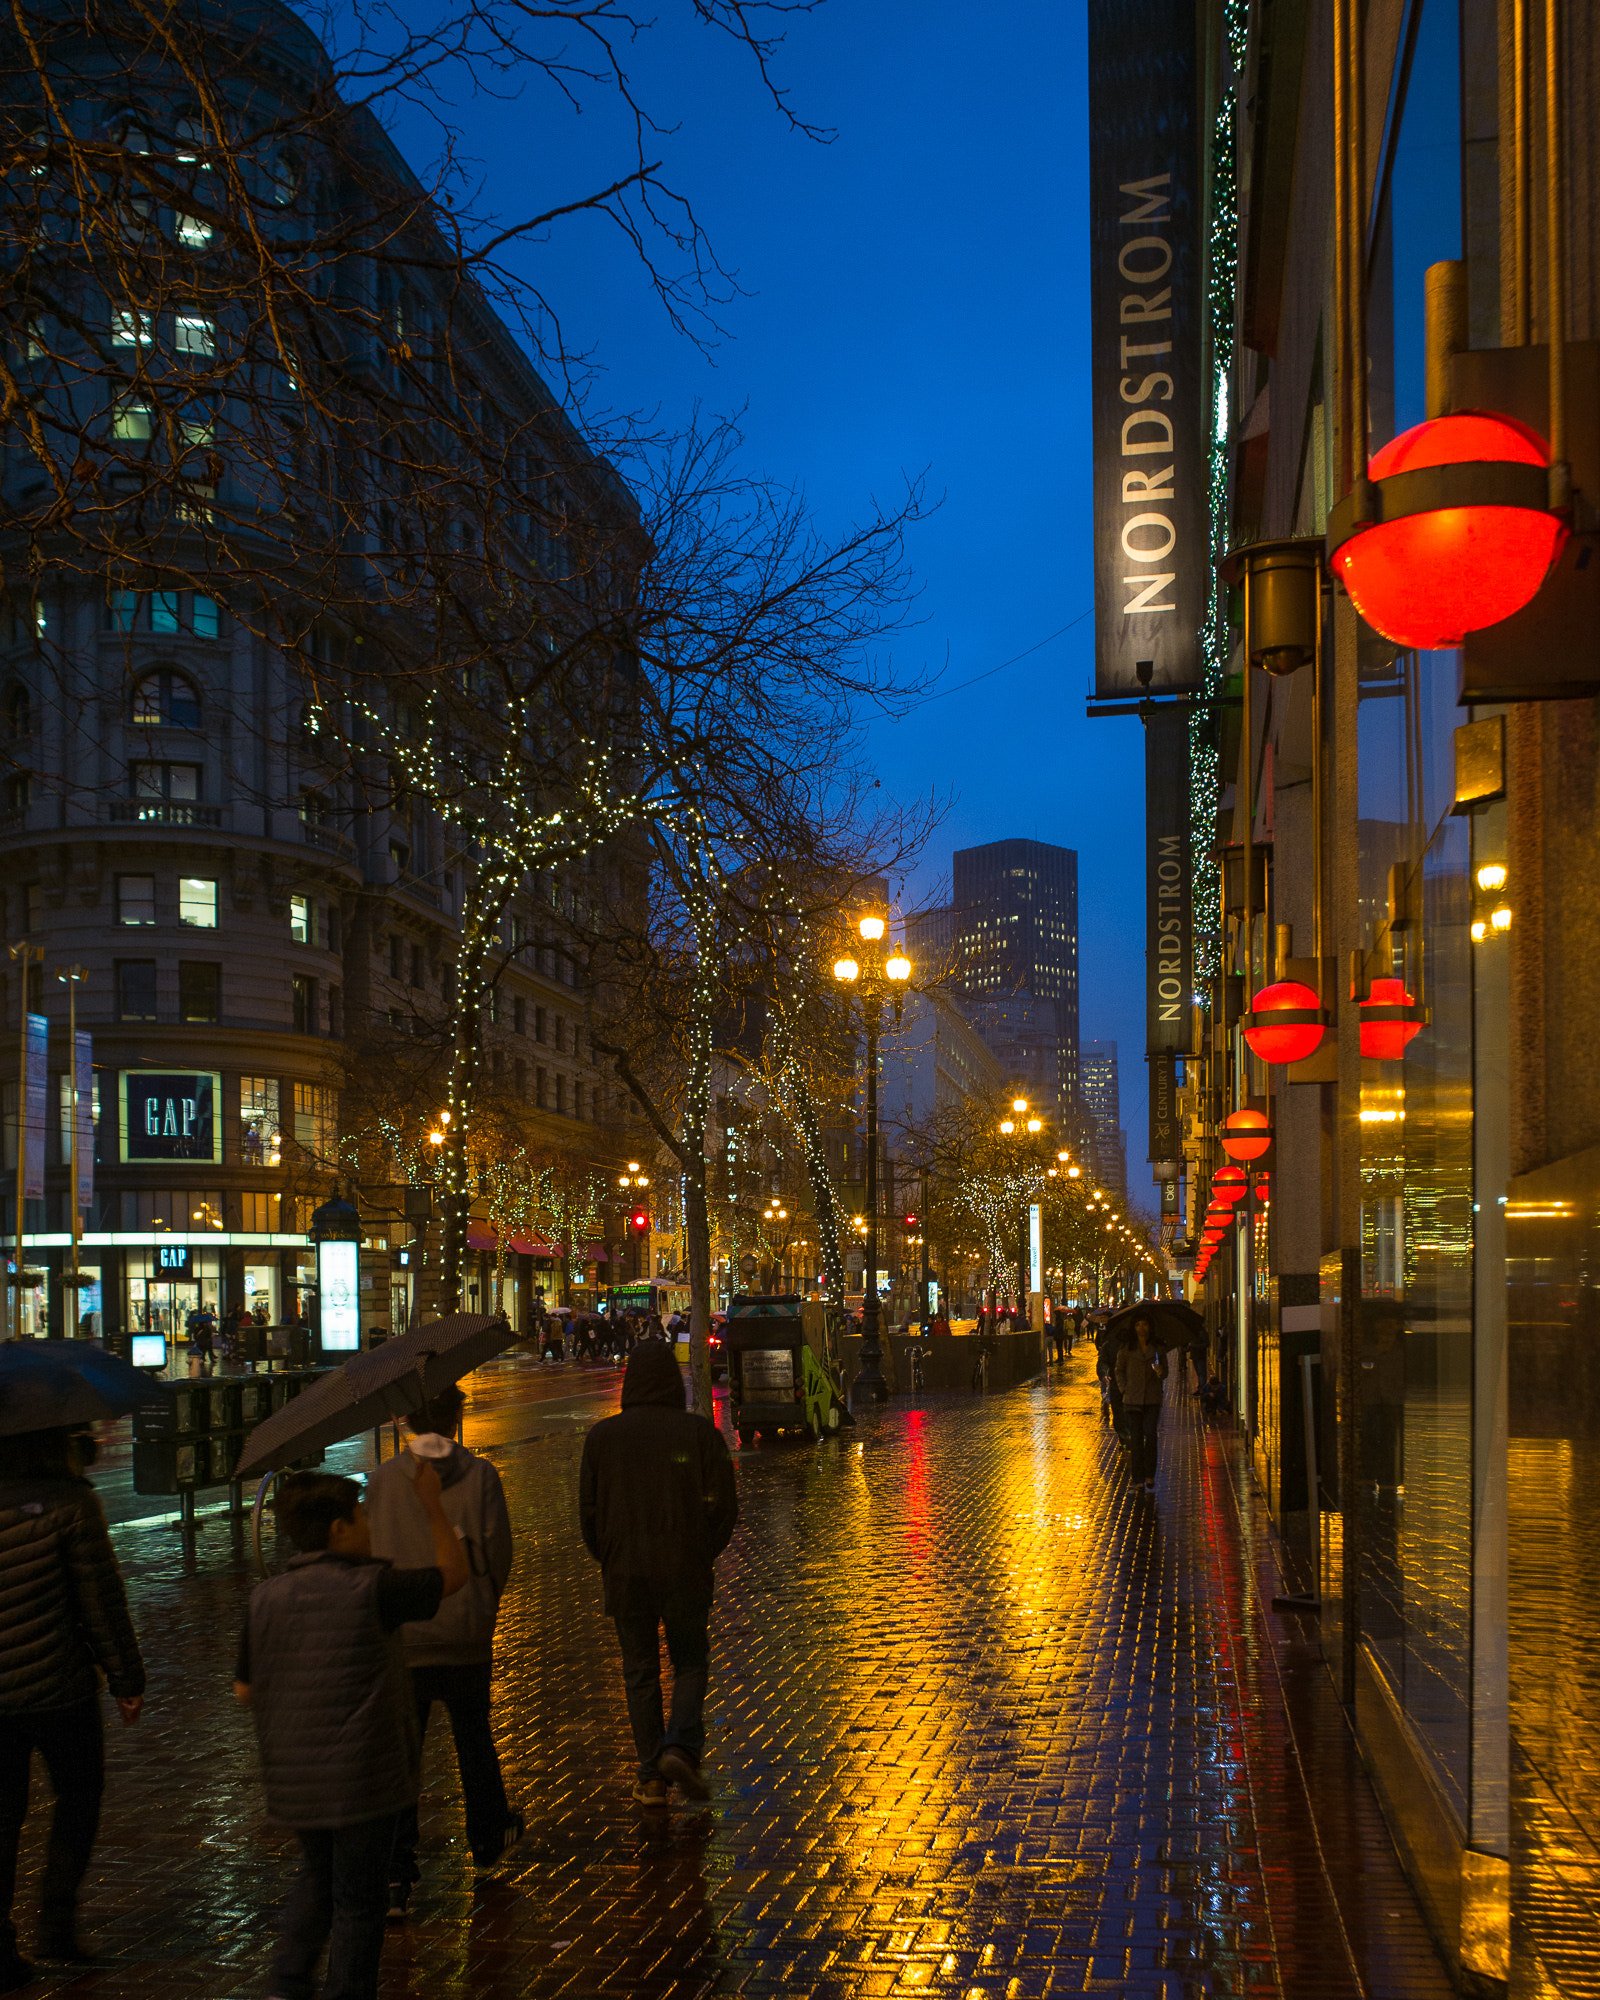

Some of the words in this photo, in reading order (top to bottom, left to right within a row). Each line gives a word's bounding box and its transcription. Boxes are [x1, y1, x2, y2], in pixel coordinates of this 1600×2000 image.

[1118, 171, 1176, 615] NORDSTROM
[1157, 835, 1181, 1021] NORDSTROM
[144, 1097, 197, 1136] GAP
[1157, 1069, 1168, 1119] CENTURY
[160, 1248, 187, 1267] GAP
